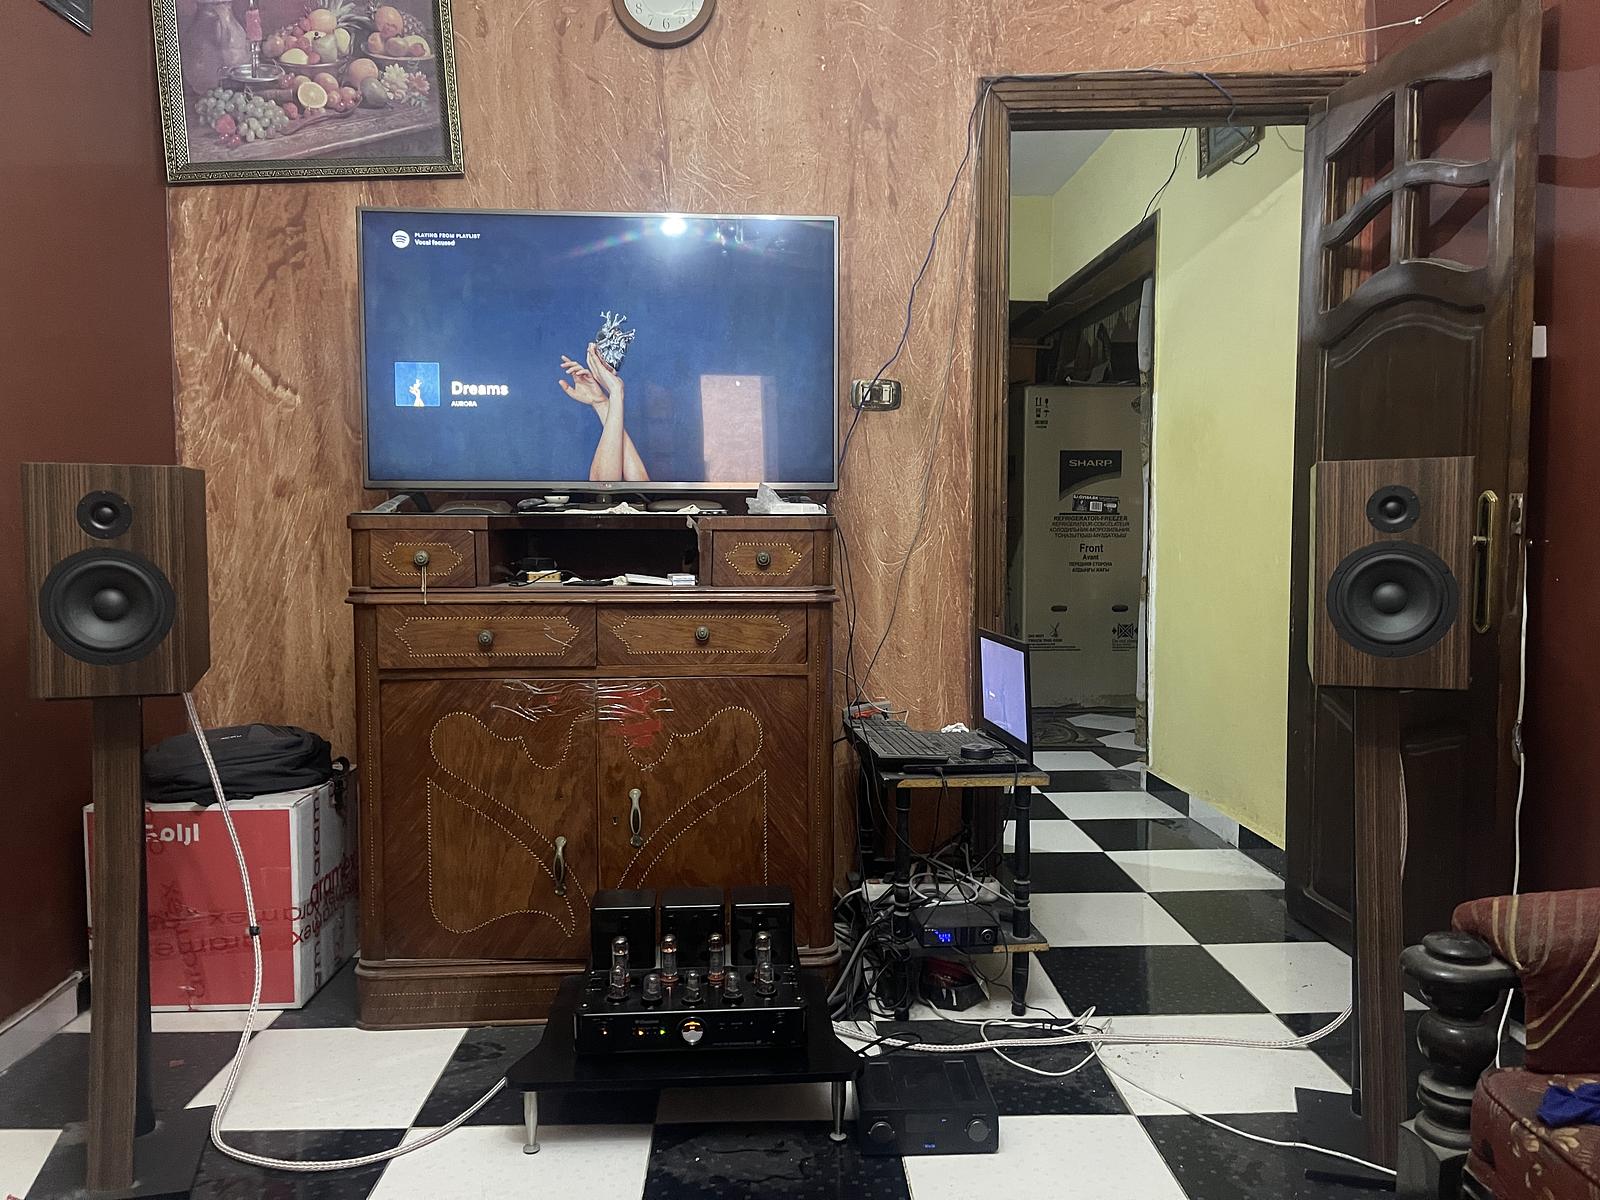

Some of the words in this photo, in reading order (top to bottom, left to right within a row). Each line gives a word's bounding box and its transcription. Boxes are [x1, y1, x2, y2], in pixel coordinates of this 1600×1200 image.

[451, 381, 509, 396] Dreams
[451, 400, 478, 408] AURORA
[1068, 459, 1113, 468] SHARP
[1079, 543, 1104, 553] Front
